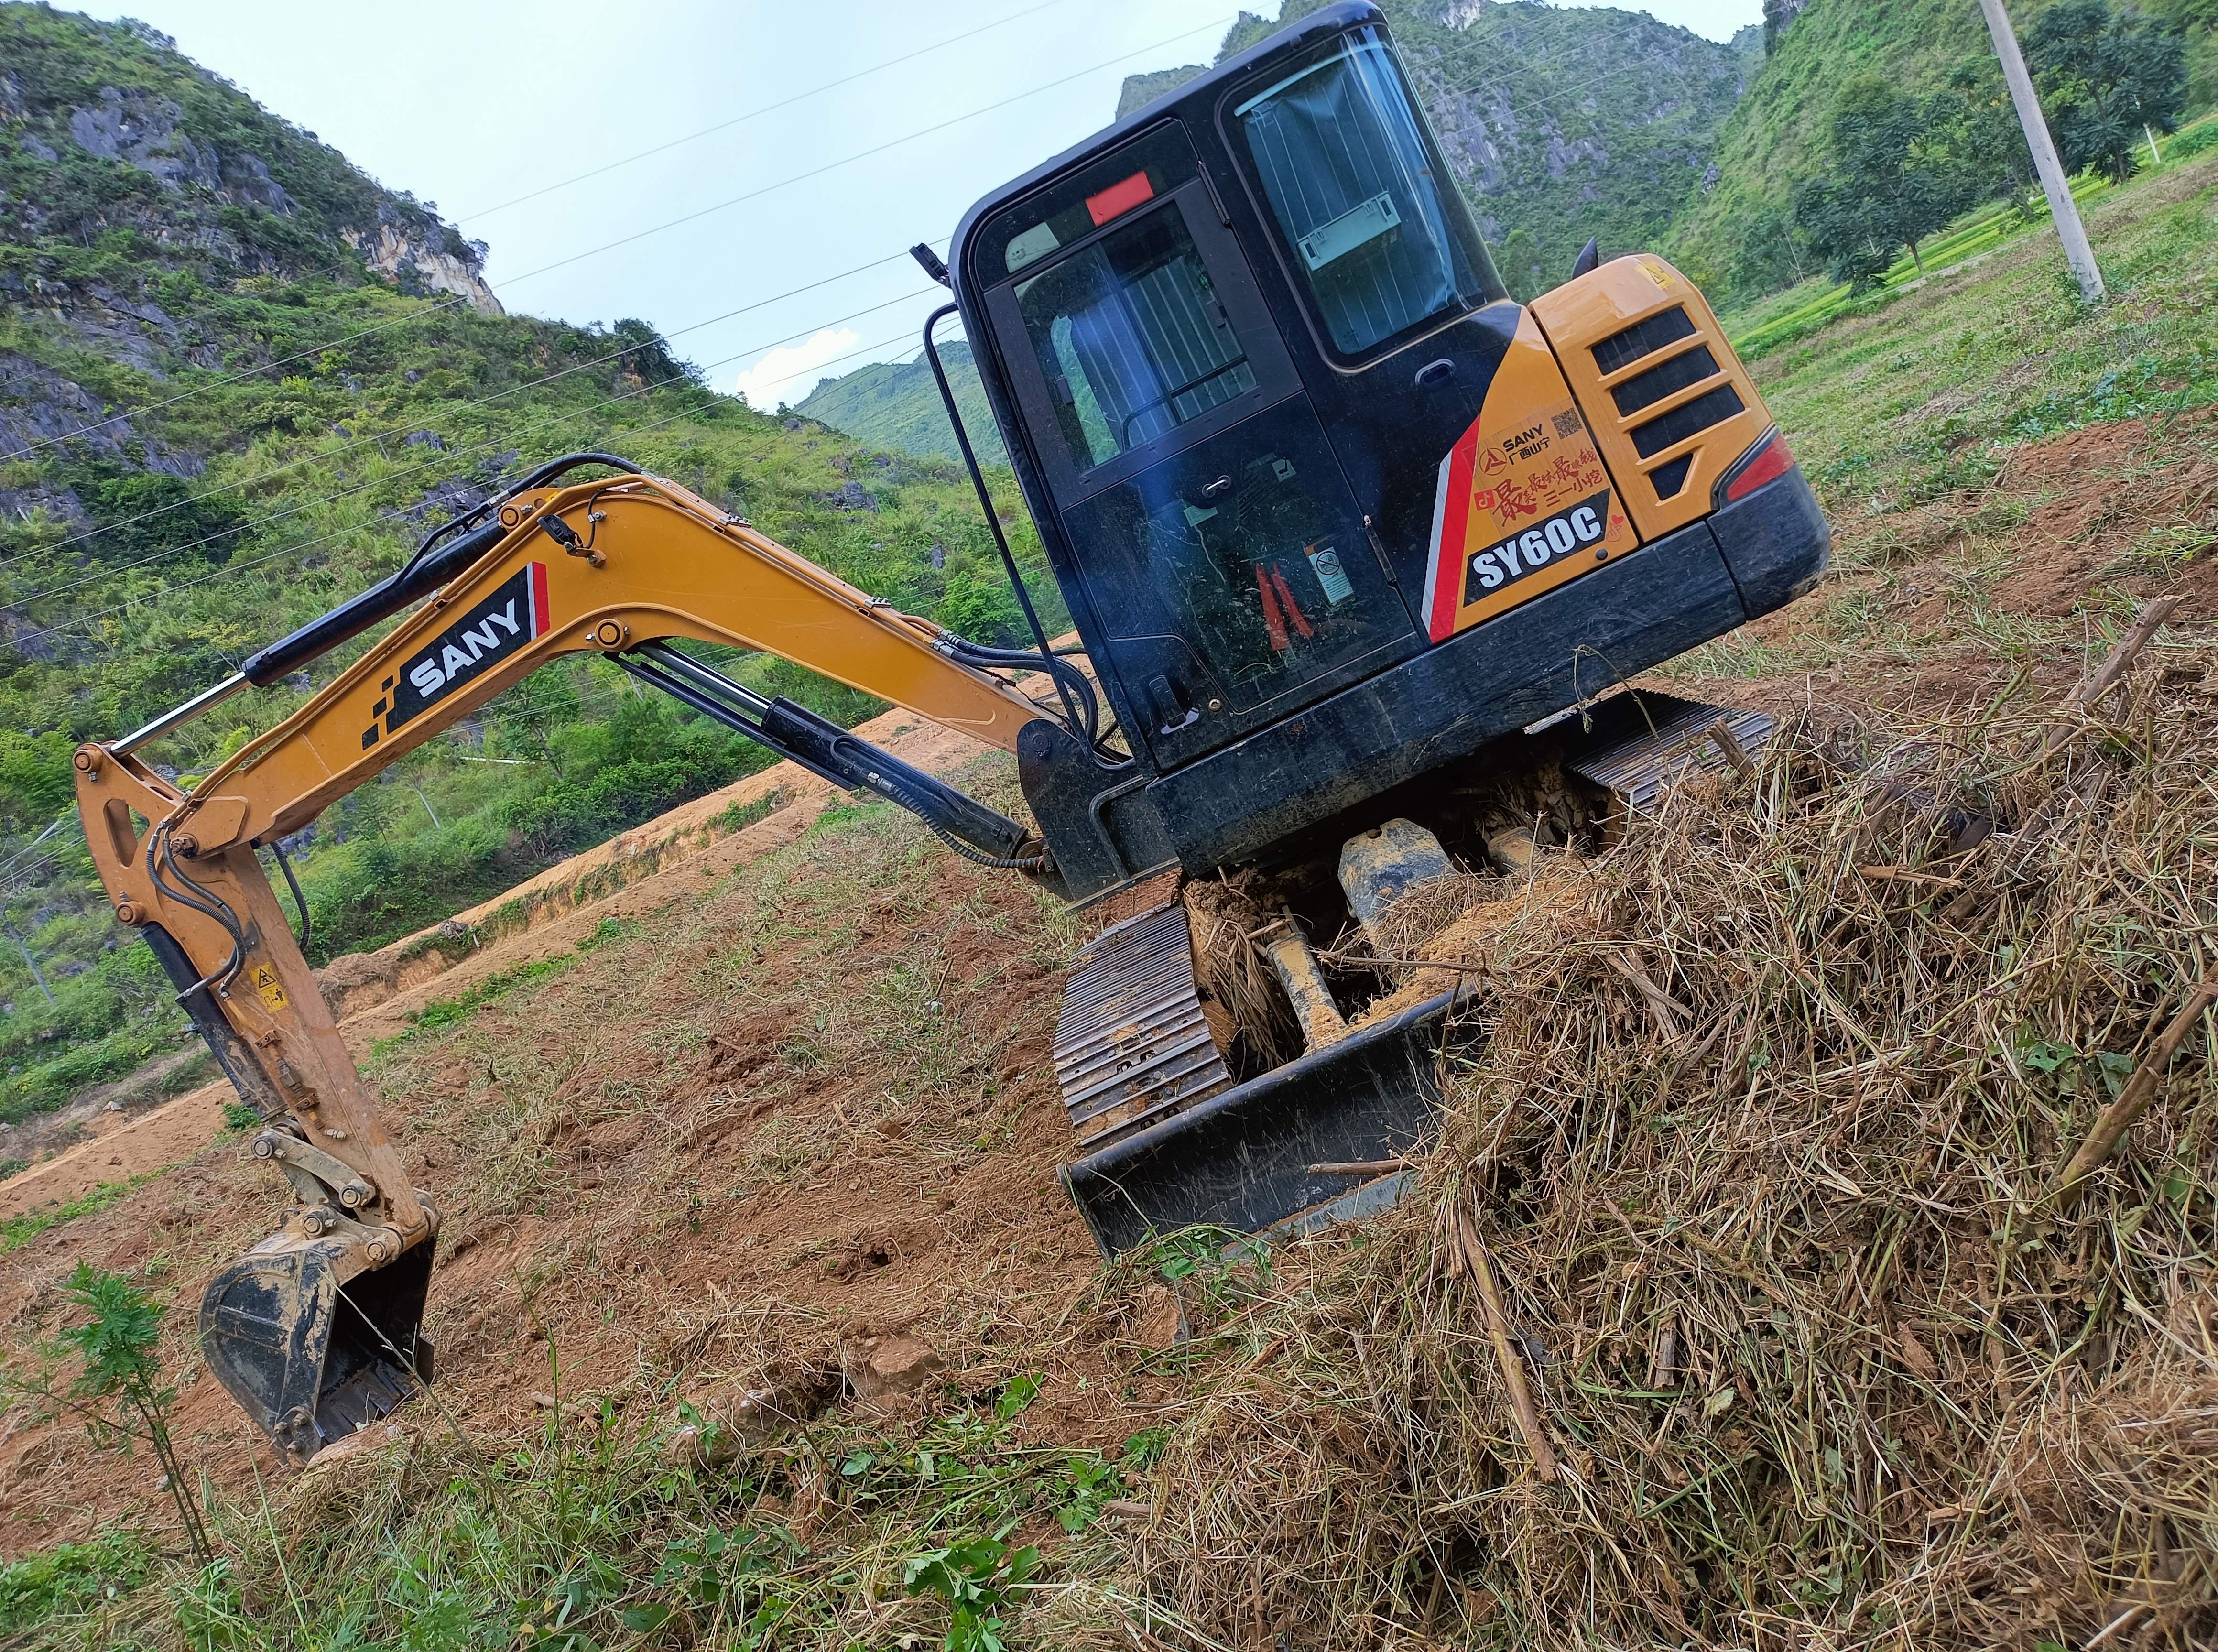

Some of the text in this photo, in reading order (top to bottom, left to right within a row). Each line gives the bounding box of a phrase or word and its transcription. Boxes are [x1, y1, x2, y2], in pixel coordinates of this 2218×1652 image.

[1503, 424, 1542, 452] SANY
[1509, 437, 1550, 465] 广西山宁
[1543, 469, 1603, 507] 三一小挖
[1472, 506, 1602, 588] SY60C
[409, 598, 521, 698] SANY
